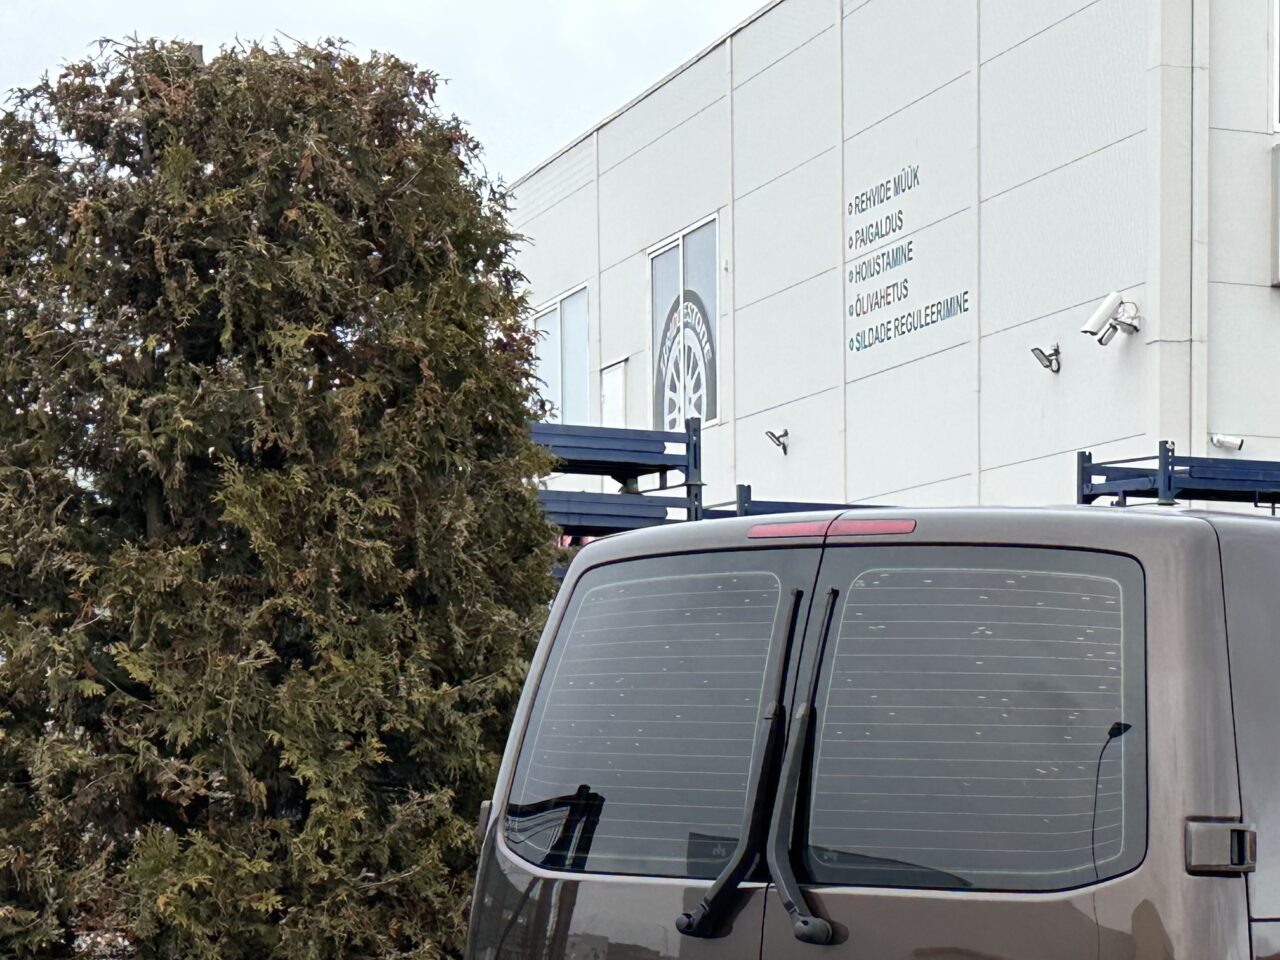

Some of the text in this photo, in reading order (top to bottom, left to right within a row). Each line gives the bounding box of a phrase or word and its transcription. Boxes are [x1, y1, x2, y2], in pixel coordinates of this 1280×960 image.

[854, 180, 891, 215] REHVIDE
[854, 209, 904, 250] PAIGALDUS
[854, 240, 914, 283] HOIUSTAMINE
[854, 290, 969, 352] SILDADE REGULEERIMINE
